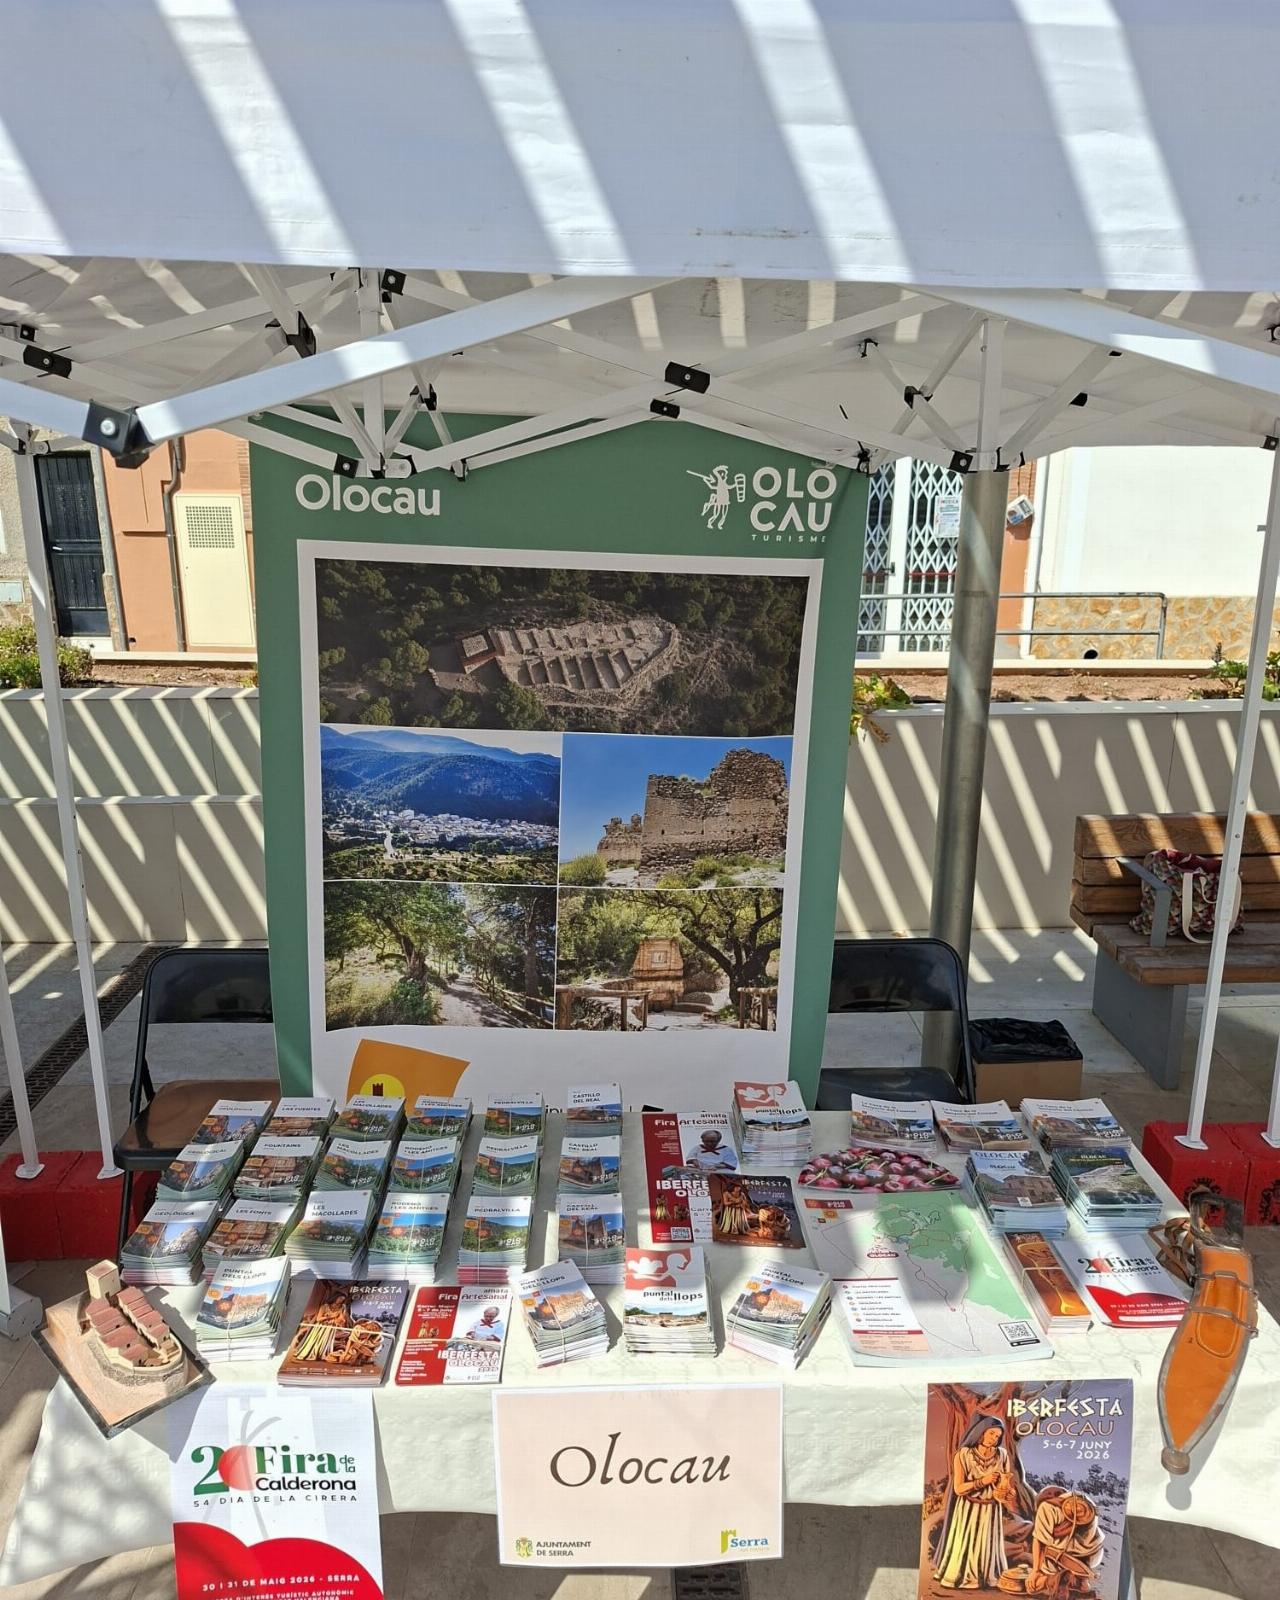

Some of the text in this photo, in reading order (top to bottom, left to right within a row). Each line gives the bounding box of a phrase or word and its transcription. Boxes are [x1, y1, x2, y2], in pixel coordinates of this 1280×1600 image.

[752, 466, 837, 500] OLO
[295, 473, 441, 516] Olocau
[750, 501, 833, 532] CAU
[751, 534, 826, 543] TURISME
[656, 1180, 709, 1190] IBERFE
[675, 1189, 709, 1197] OLO
[349, 1285, 402, 1294] IBERFESTA
[643, 1290, 673, 1298] puntal
[674, 1292, 703, 1302] llops
[437, 1349, 500, 1360] IBERFESTA
[1006, 1397, 1124, 1418] IBERFESTA
[1015, 1421, 1115, 1437] OLOCAU
[1042, 1440, 1113, 1450] 5-6-7 JUNY
[254, 1444, 341, 1474] Fira
[550, 1431, 731, 1487] Olocau
[1076, 1450, 1110, 1460] 2026
[255, 1477, 357, 1491] Calderona
[219, 1496, 244, 1504] DIA
[253, 1495, 270, 1503] DE
[536, 1540, 592, 1549] AJUNTAMENT
[730, 1537, 769, 1548] Serra
[536, 1549, 574, 1557] DE SERRA
[242, 1579, 256, 1587] DE
[260, 1577, 286, 1586] MAIG
[290, 1575, 315, 1584] 2026
[327, 1574, 360, 1583] SERRA
